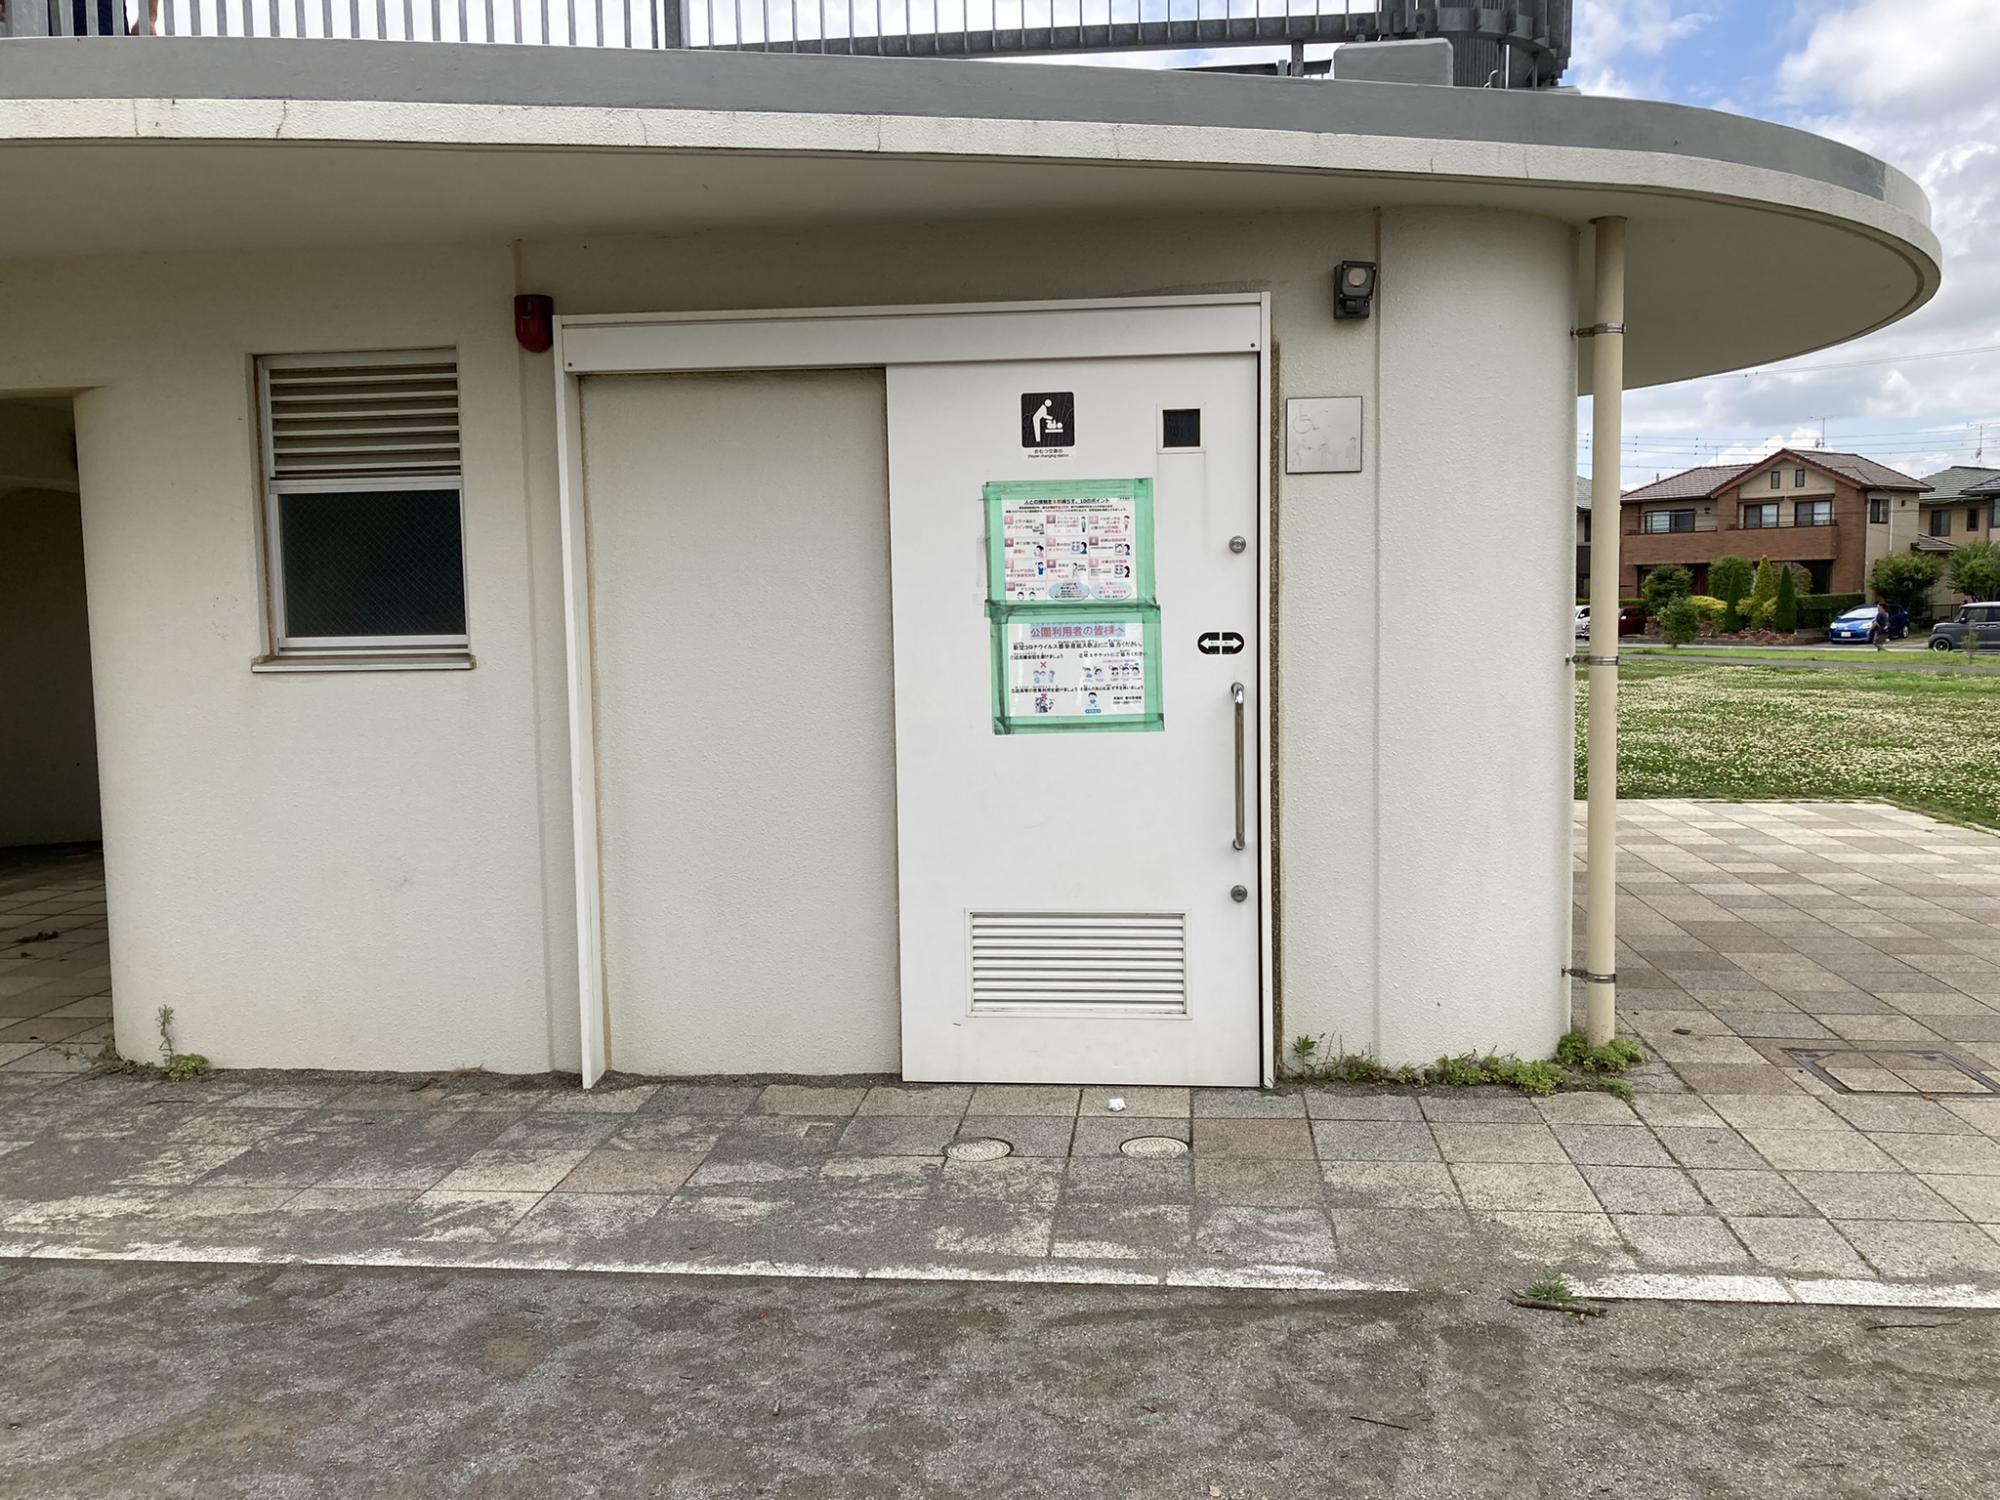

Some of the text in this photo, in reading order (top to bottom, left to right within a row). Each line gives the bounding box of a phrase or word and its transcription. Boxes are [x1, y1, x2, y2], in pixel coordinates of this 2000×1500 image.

[1030, 625, 1125, 638] 公園利用者の皆様へ
